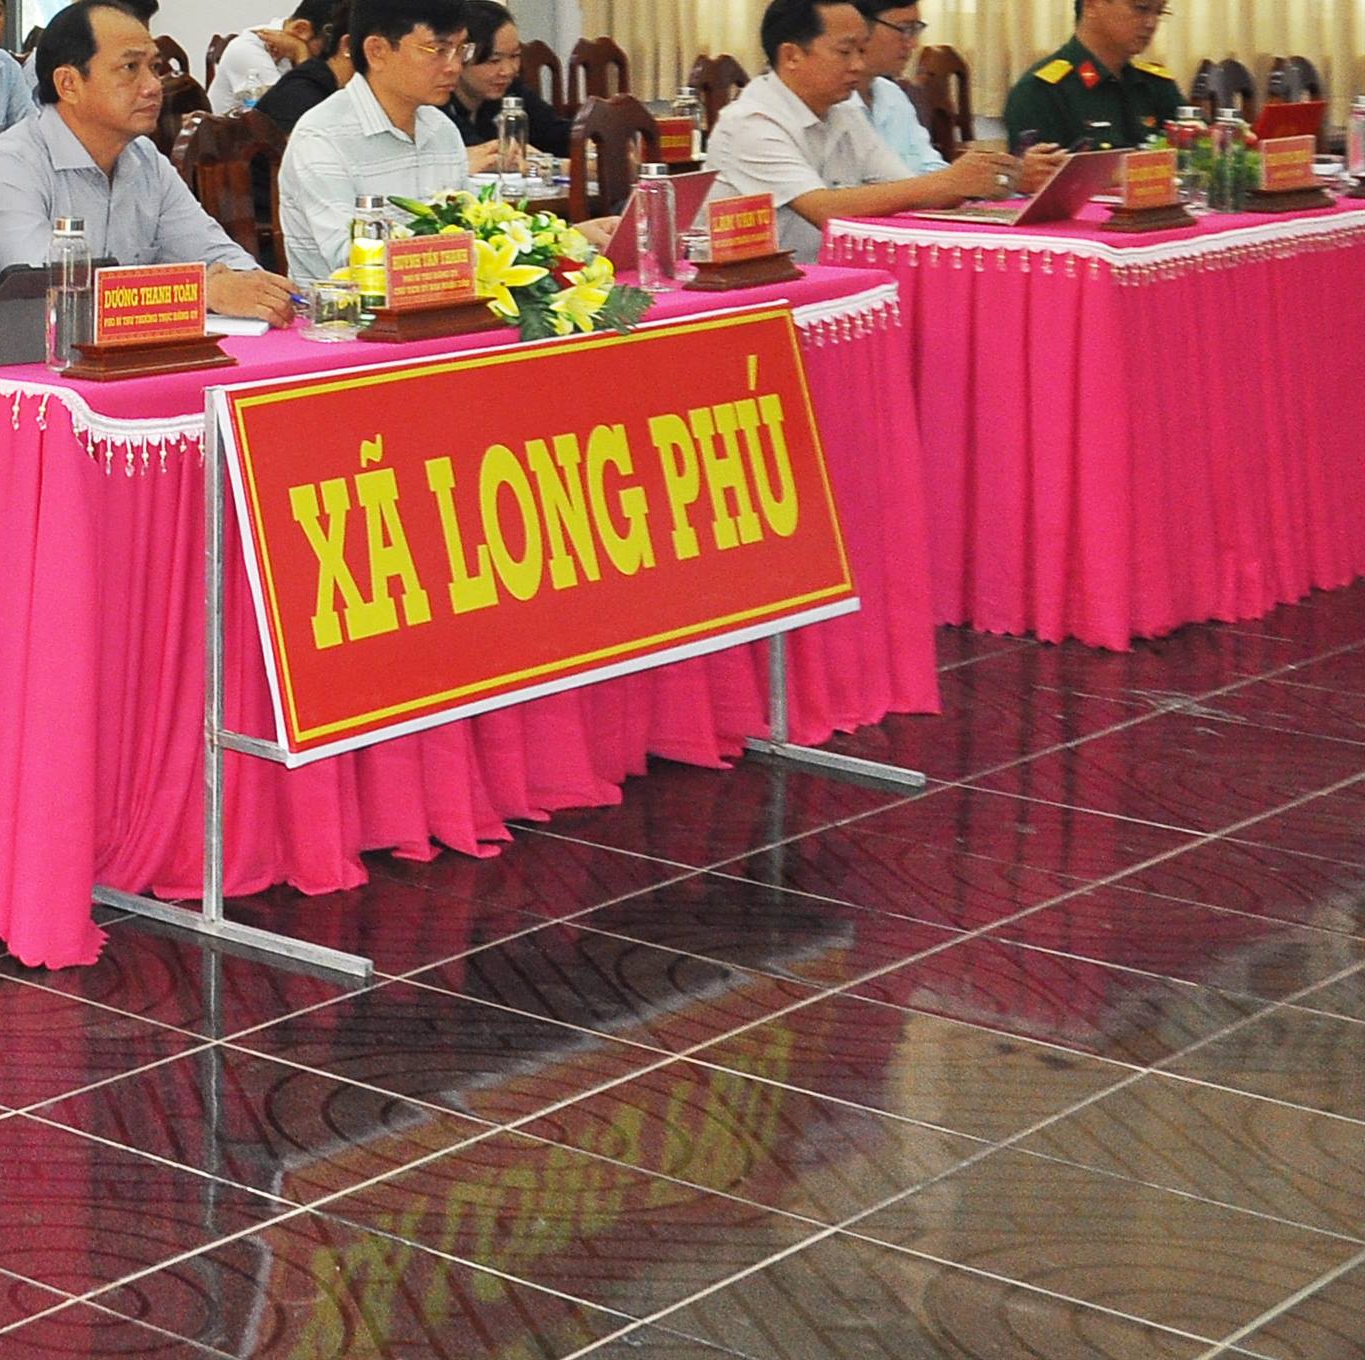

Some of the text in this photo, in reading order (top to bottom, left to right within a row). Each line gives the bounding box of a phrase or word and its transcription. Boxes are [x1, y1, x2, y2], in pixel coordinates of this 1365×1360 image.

[140, 285, 172, 306] THANH
[289, 354, 799, 650] XÃ LONG PHÚ
